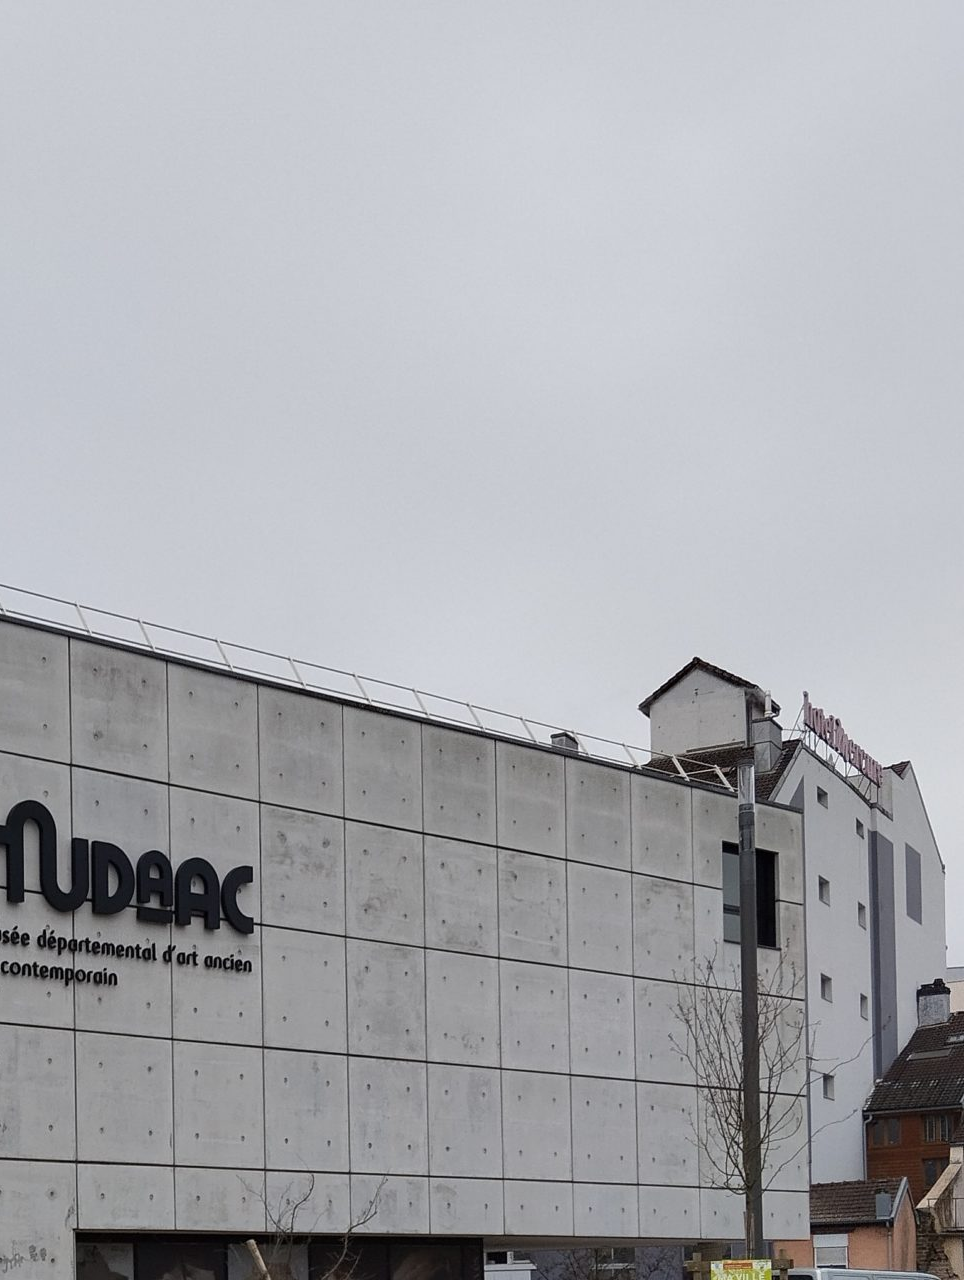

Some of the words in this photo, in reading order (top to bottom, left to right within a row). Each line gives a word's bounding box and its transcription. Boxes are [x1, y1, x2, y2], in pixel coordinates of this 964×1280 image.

[37, 929, 157, 963] départemental
[162, 944, 199, 968] d'art
[204, 953, 253, 973] ancien
[0, 957, 118, 986] contemporain
